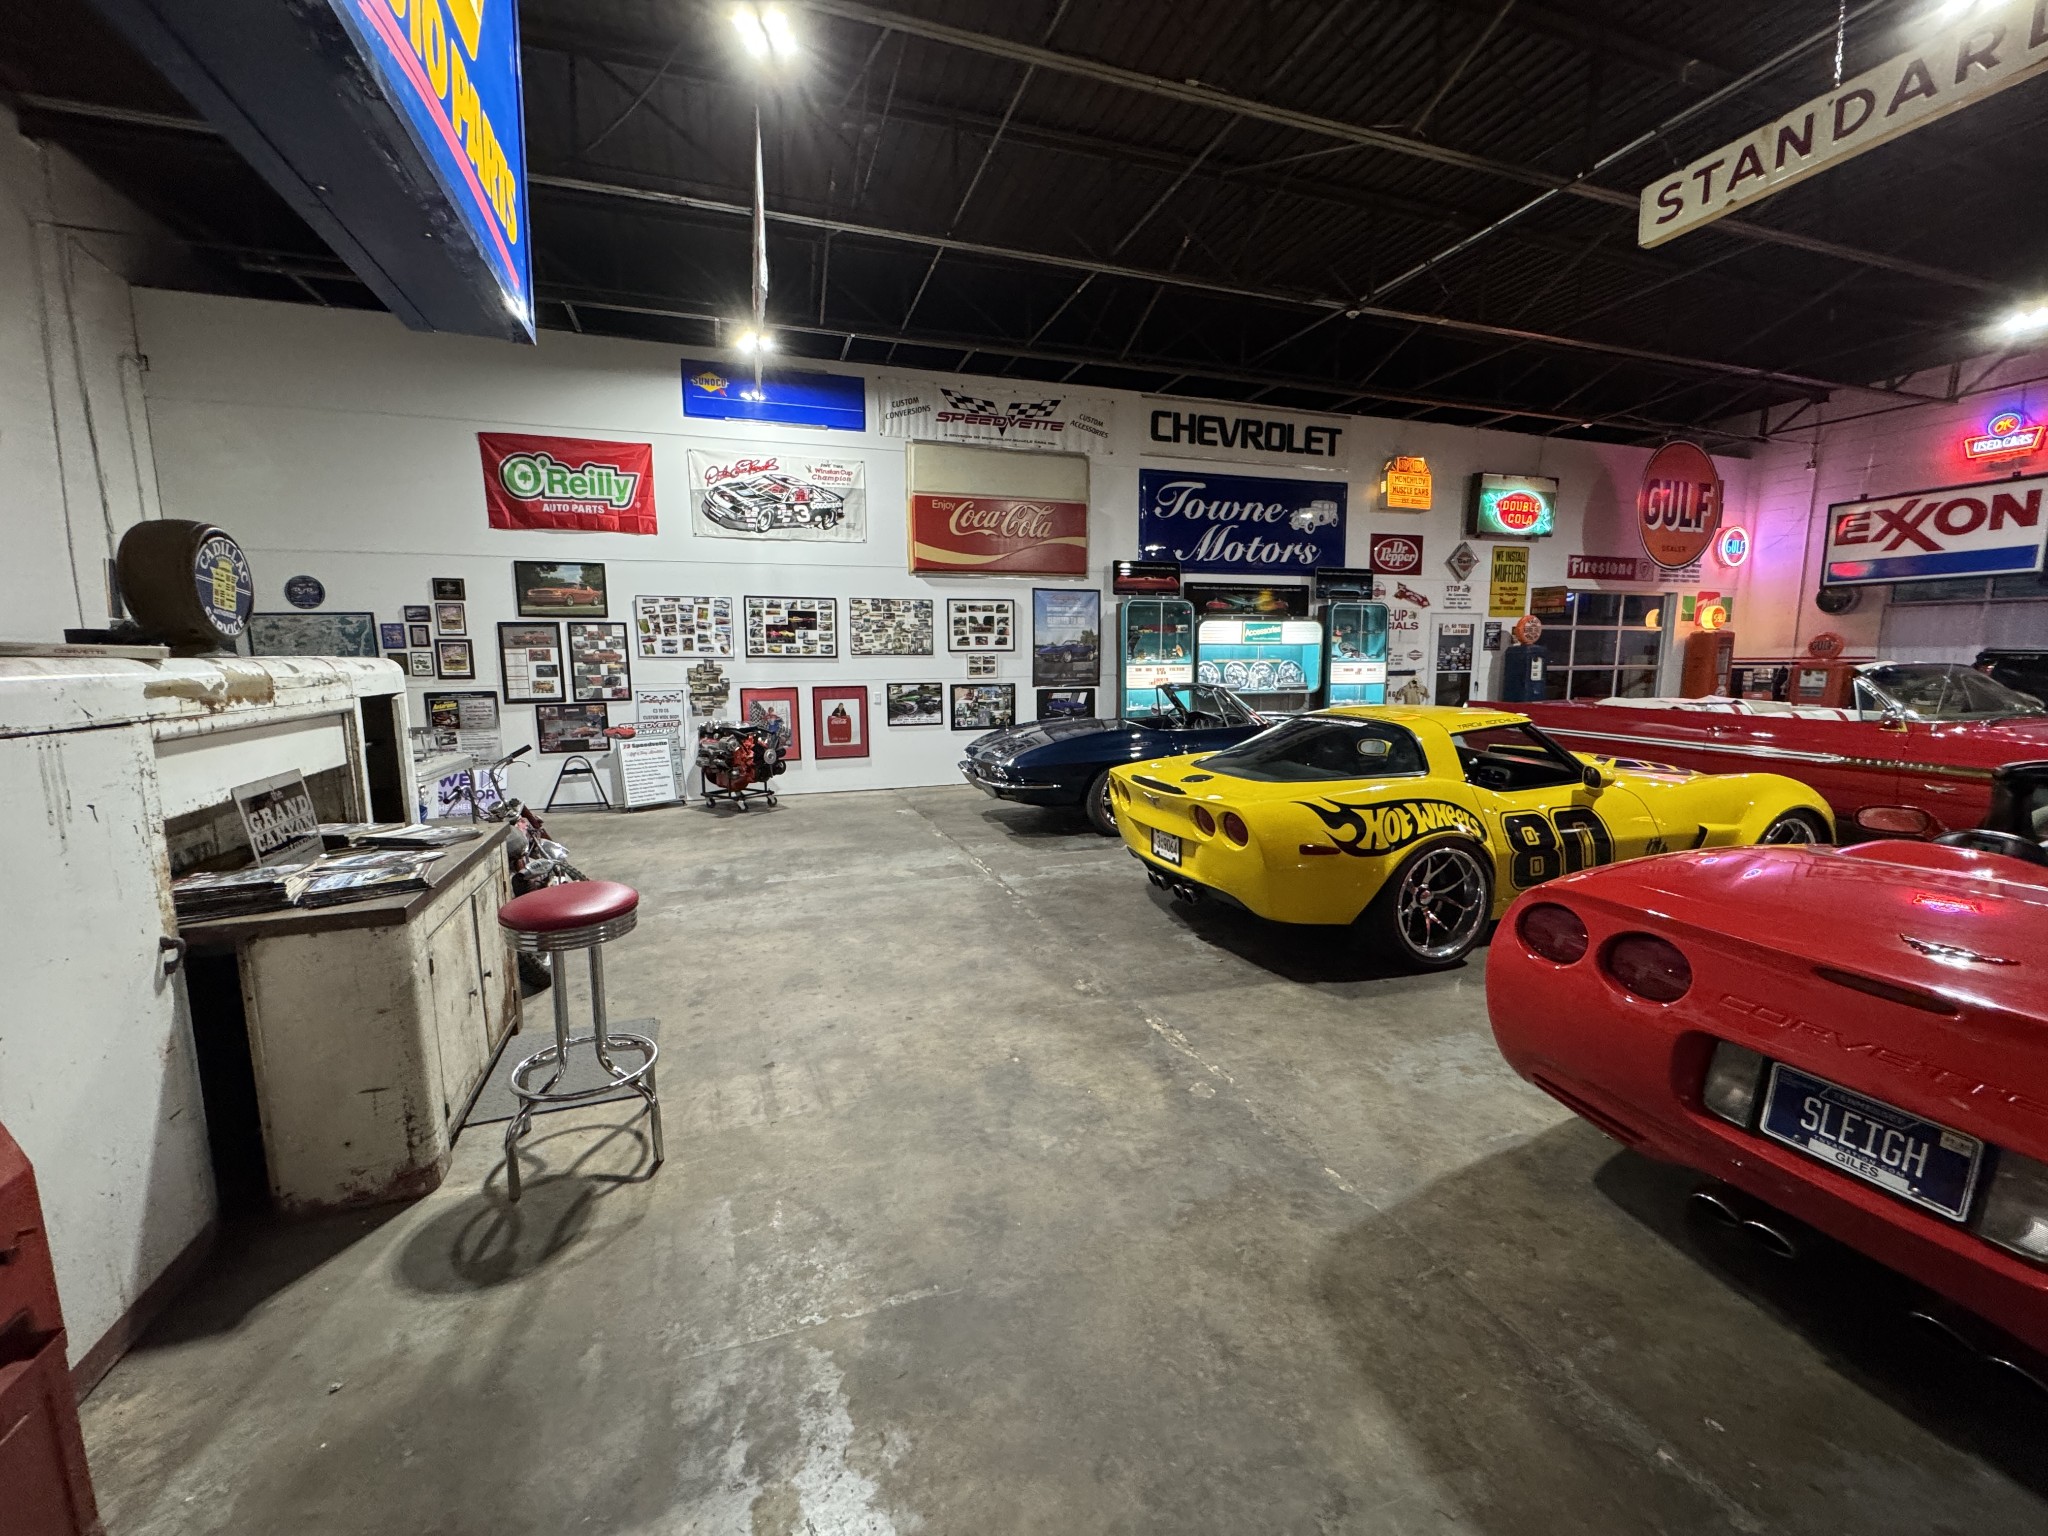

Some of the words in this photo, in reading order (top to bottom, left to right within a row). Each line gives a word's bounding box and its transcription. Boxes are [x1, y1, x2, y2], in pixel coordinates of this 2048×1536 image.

[451, 38, 518, 244] PARTS
[692, 375, 728, 388] SUNOCO
[885, 404, 931, 420] CONVERSIONS
[891, 397, 920, 408] CUSTOM
[935, 411, 1065, 433] SPEEDVETTE
[1070, 420, 1109, 439] ACCESSORIES
[1079, 413, 1104, 427] CUSTOM
[1994, 417, 2015, 434] OK
[1150, 410, 1343, 457] CHEVROLET
[1973, 437, 2000, 453] USED
[2002, 433, 2034, 449] CARS
[503, 457, 632, 503] O'Reilly
[812, 474, 852, 482] Champion
[841, 469, 853, 477] Cup
[1392, 486, 1412, 494] MUSCLE
[1413, 488, 1430, 496] CARS
[542, 503, 570, 513] AUTO
[572, 504, 605, 514] PARTS
[1153, 481, 1289, 524] Towne
[1502, 500, 1541, 513] DOUBLE
[1643, 478, 1715, 533] GULF
[793, 504, 811, 523] 3
[931, 499, 956, 512] Enjoy
[949, 500, 1056, 539] Coca-Cola
[1507, 513, 1534, 525] COLA
[1833, 488, 2044, 552] EXXON
[1173, 523, 1322, 566] Motors
[1391, 541, 1409, 554] Dr
[1661, 544, 1687, 553] DEALER
[1725, 538, 1746, 555] GULF
[200, 541, 249, 584] CADILLAC
[1379, 546, 1417, 567] Pepper
[1495, 550, 1505, 562] WE
[1505, 551, 1526, 563] INSTALL
[1494, 564, 1526, 583] MUFFLERS
[1570, 557, 1635, 577] Firestone
[205, 605, 245, 635] SERVICE
[1245, 625, 1281, 638] Accessories
[248, 794, 311, 834] GRAND
[255, 814, 316, 852] CANYON
[1500, 804, 1616, 891] 80
[1800, 1096, 1929, 1179] SLEIGH
[1834, 1151, 1880, 1179] GILES
